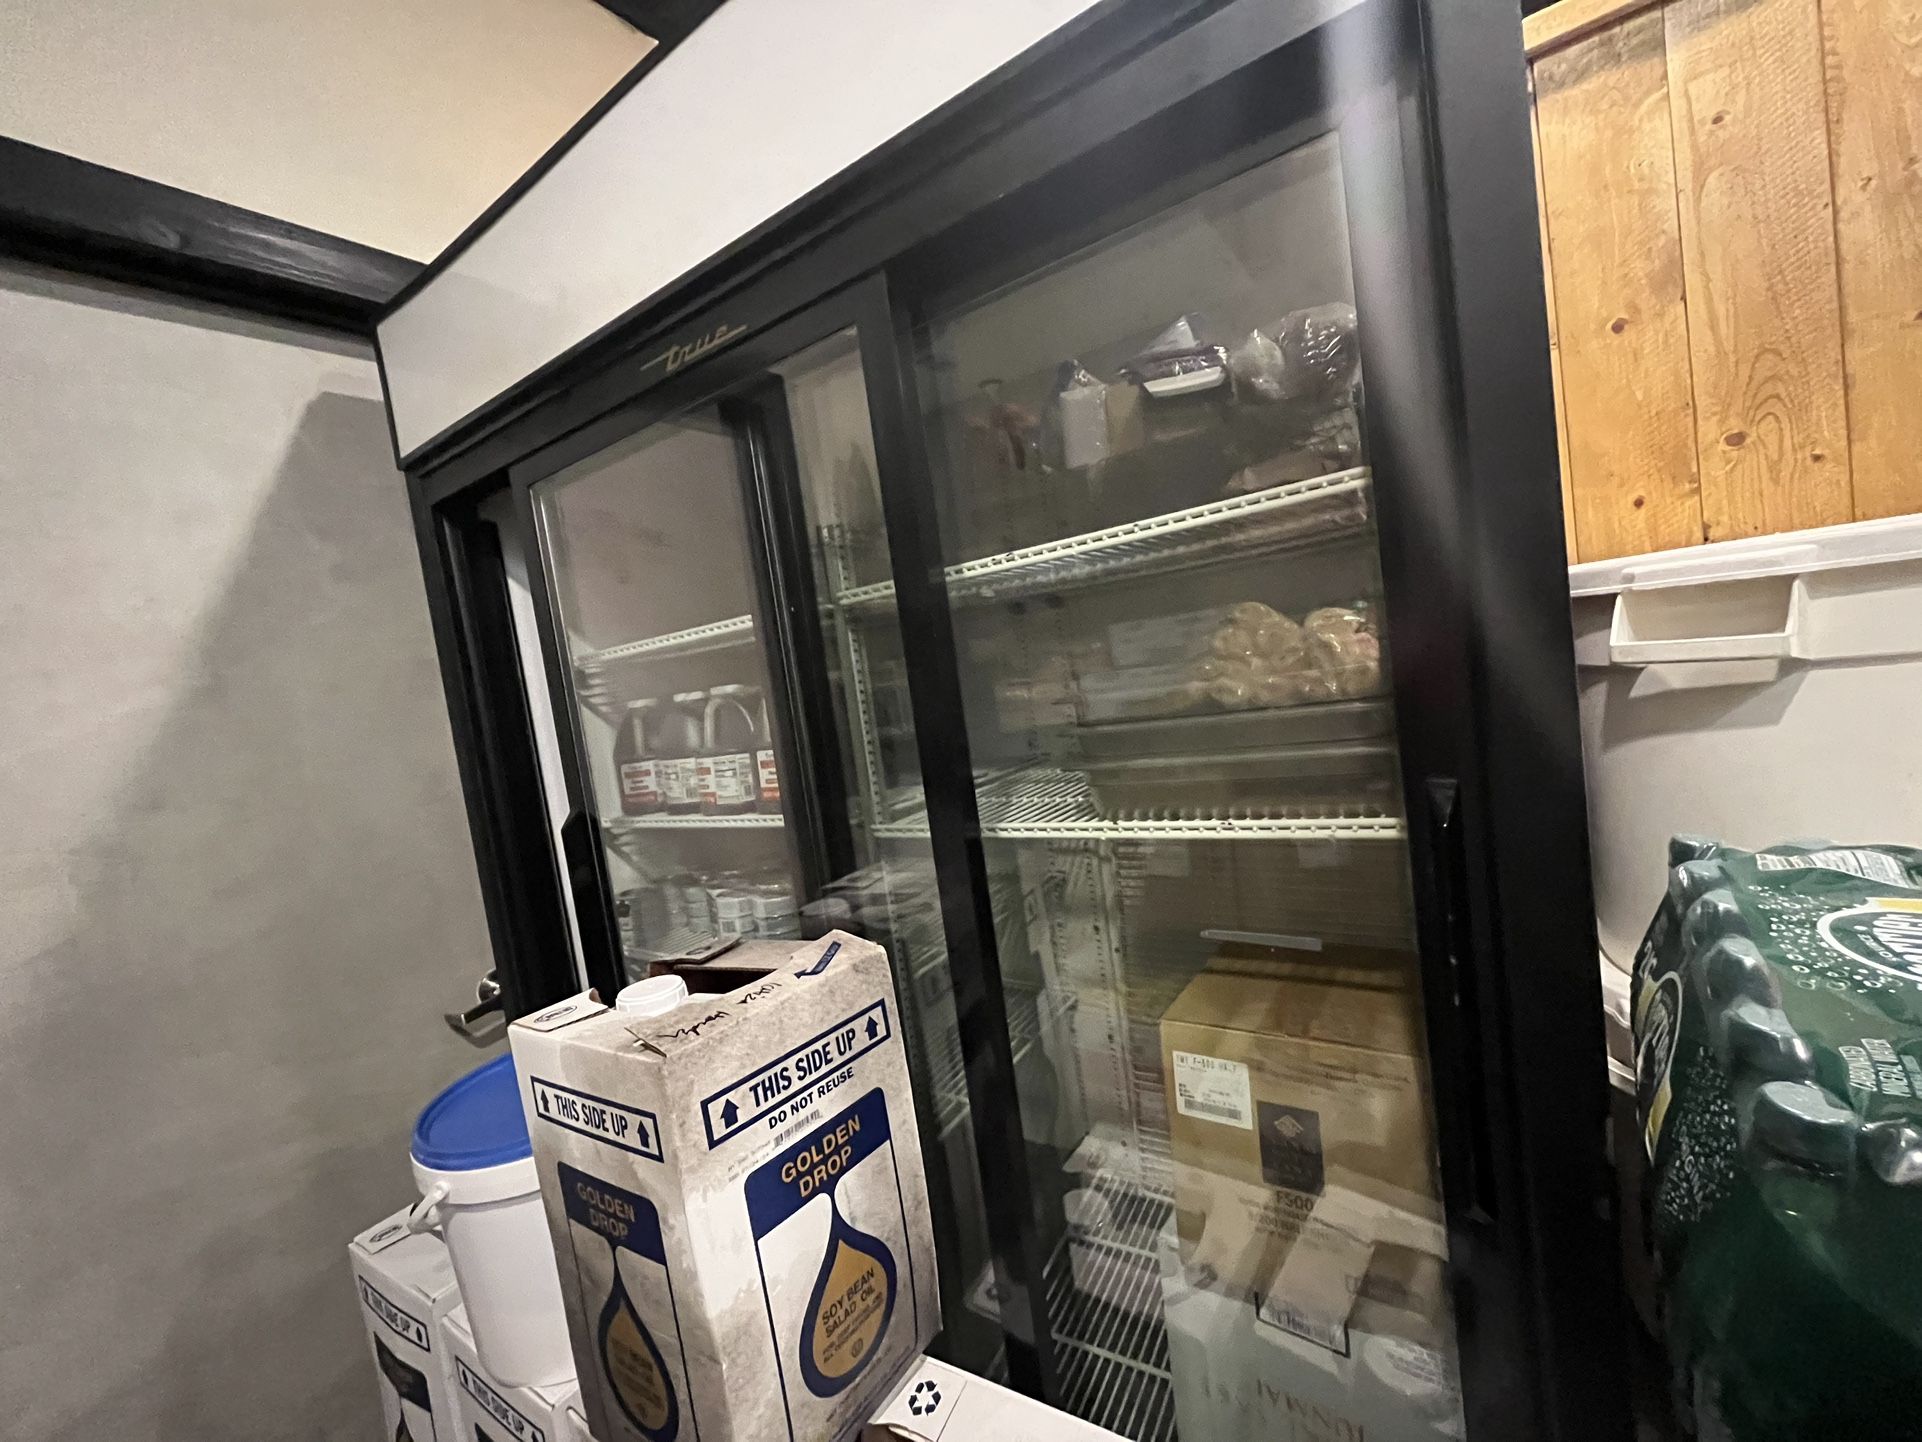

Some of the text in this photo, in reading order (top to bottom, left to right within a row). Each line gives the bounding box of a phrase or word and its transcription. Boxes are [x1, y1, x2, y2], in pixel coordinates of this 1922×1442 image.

[641, 325, 747, 373] true
[749, 1027, 856, 1108] THIS SIDE UP
[553, 1093, 628, 1138] THIS SIDE UP
[768, 1066, 854, 1130] DO NOT REUSE
[781, 1114, 860, 1183] GOLDEN
[799, 1145, 852, 1197] DROP
[577, 1181, 636, 1223] GOLDEN
[588, 1208, 629, 1240] DROP
[821, 1295, 845, 1326] SOY
[846, 1267, 875, 1301] BEAN
[825, 1301, 857, 1338] SALAD
[860, 1284, 877, 1301] OIL
